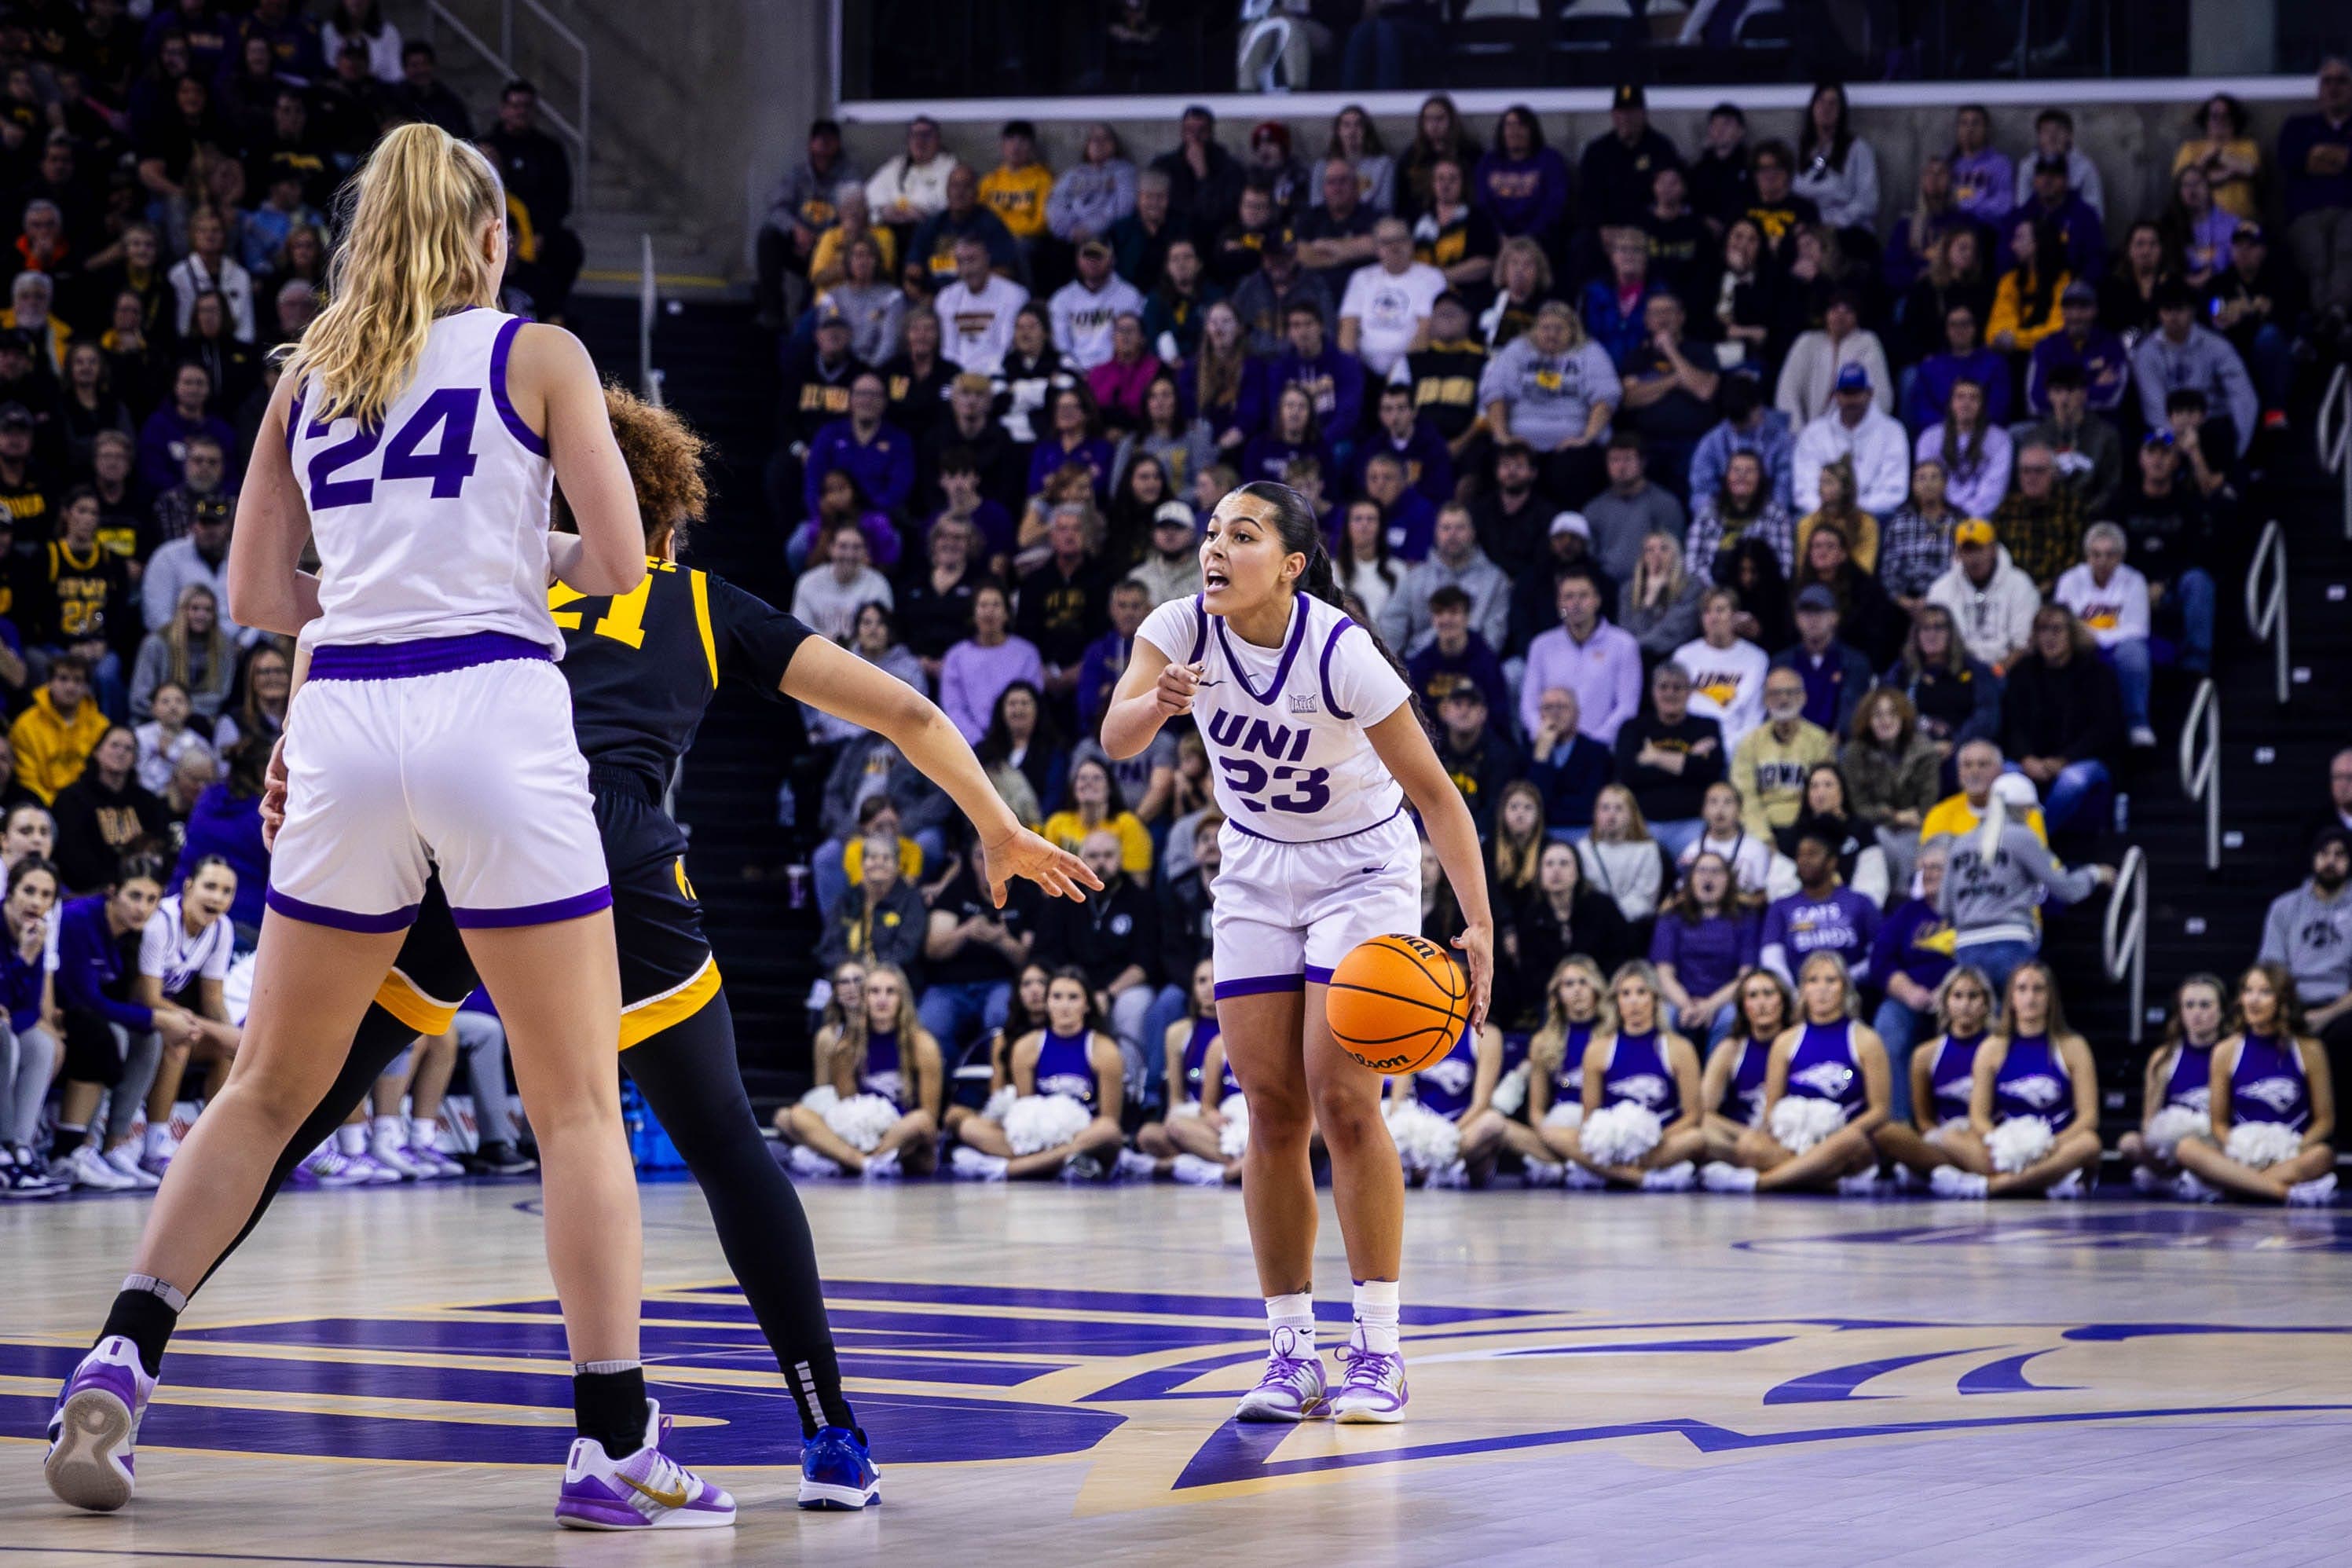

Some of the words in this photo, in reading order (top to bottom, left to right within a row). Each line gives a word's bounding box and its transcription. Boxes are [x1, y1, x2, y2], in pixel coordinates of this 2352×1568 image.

[306, 388, 482, 511] 24
[1208, 707, 1312, 762] UNI
[1218, 756, 1330, 814] 23
[1348, 1051, 1412, 1068] lson
